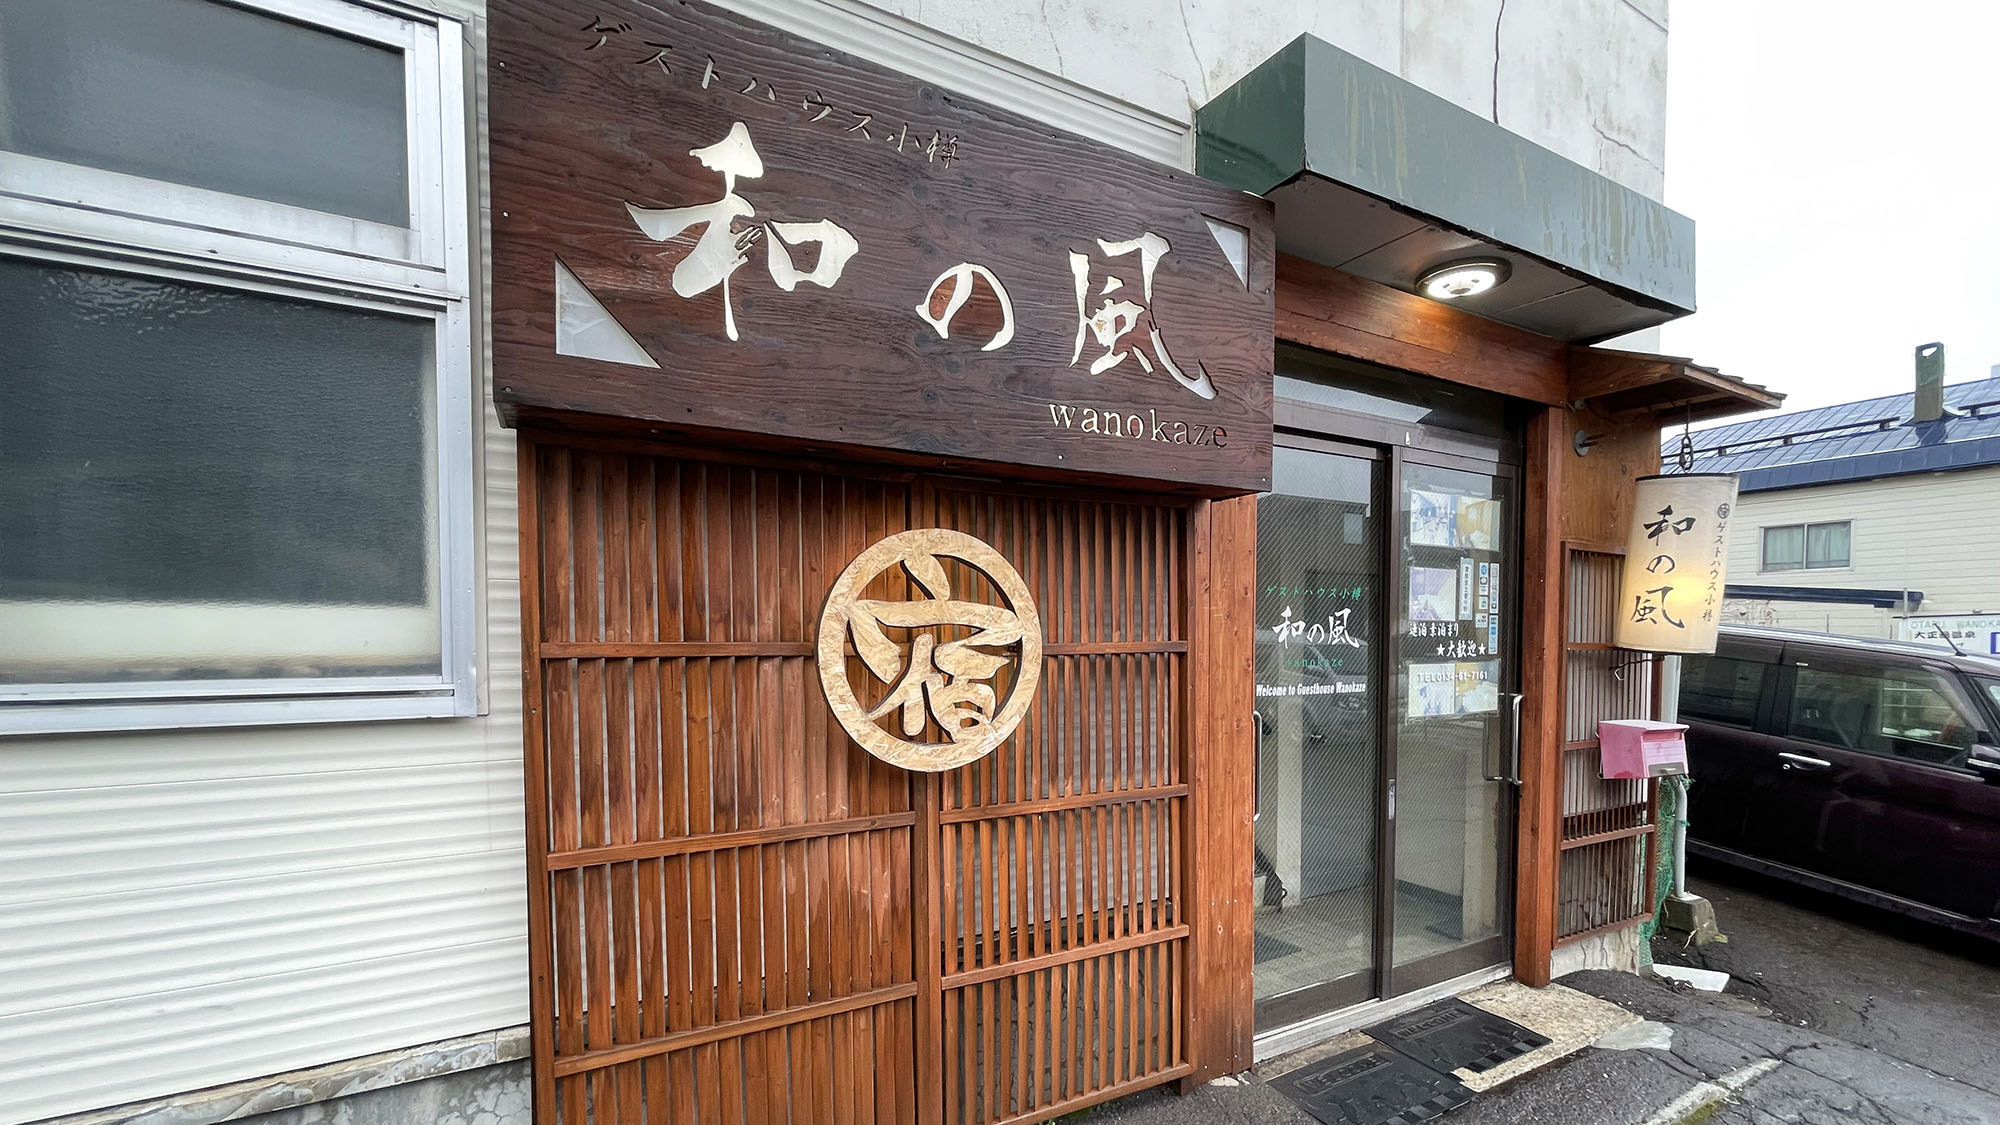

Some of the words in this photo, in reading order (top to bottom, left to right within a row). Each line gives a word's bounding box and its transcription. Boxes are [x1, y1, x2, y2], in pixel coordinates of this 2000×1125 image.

[582, 16, 960, 170] ゲストハウス小樽
[625, 121, 1218, 400] 和の風
[1049, 403, 1228, 448] wanokaze
[1630, 505, 1696, 629] 和の風
[1702, 522, 1727, 622] ゲストハウス小樽
[1266, 585, 1362, 600] ゲストハウス小樽
[1272, 605, 1360, 649] 和の風
[1256, 684, 1286, 697] Welcome
[1288, 685, 1295, 696] to
[1297, 683, 1335, 695] Guesthouse
[1336, 681, 1366, 694] Wanokaze
[1396, 1010, 1460, 1038] WELCOME
